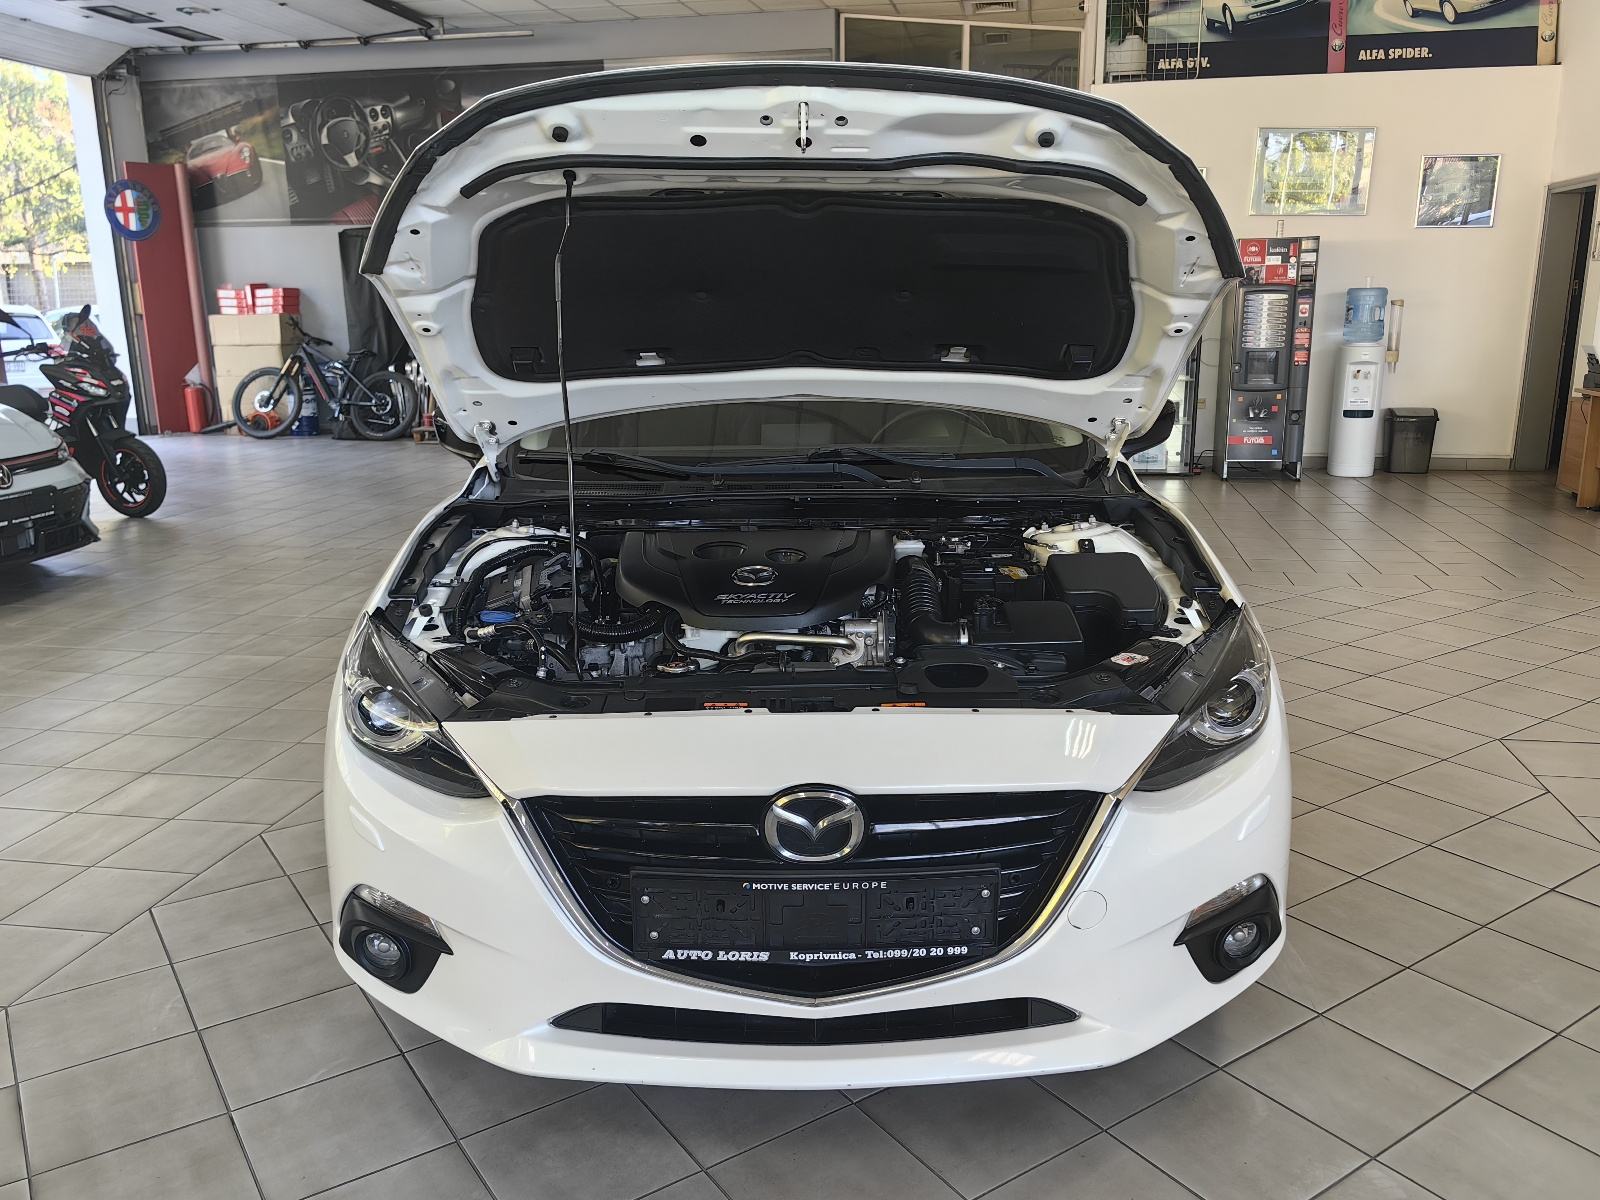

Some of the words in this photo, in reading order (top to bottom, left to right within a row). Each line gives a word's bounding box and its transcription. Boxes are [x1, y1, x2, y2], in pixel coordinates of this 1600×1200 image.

[1357, 49, 1385, 61] ALFA
[1388, 47, 1433, 59] SPIDER.
[1157, 58, 1184, 70] ALFA
[752, 883, 789, 891] MOTIVE
[833, 881, 888, 890] EUROPE
[661, 949, 713, 961] AUTO
[716, 950, 771, 962] LORIS
[789, 951, 857, 962] Koprivnica
[865, 948, 927, 959] Tel:099/20
[930, 947, 944, 956] 20
[947, 946, 968, 955] 999
